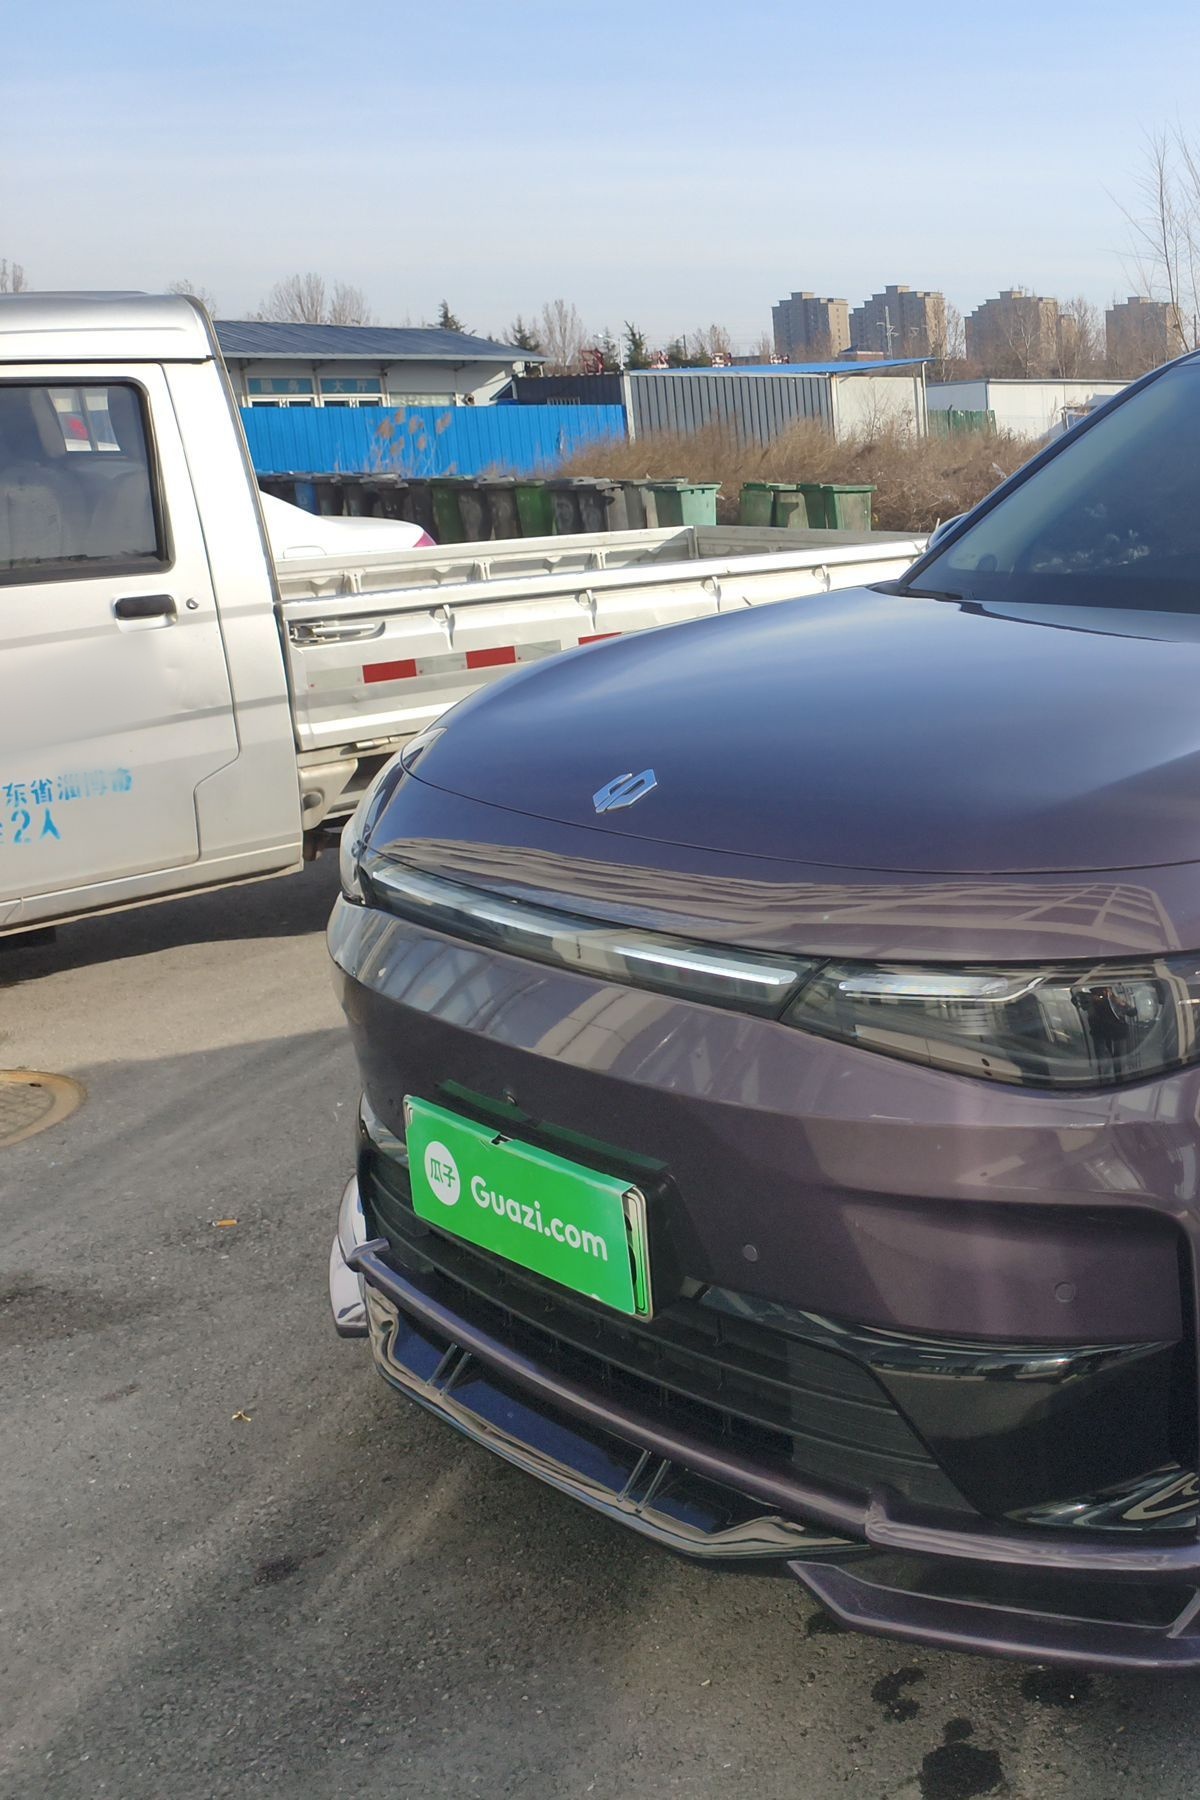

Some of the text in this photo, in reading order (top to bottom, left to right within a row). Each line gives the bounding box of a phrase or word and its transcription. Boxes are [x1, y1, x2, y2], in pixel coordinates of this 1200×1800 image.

[0, 807, 61, 844] 2人
[430, 1157, 456, 1188] 瓜子
[470, 1175, 608, 1262] Guazi.com
